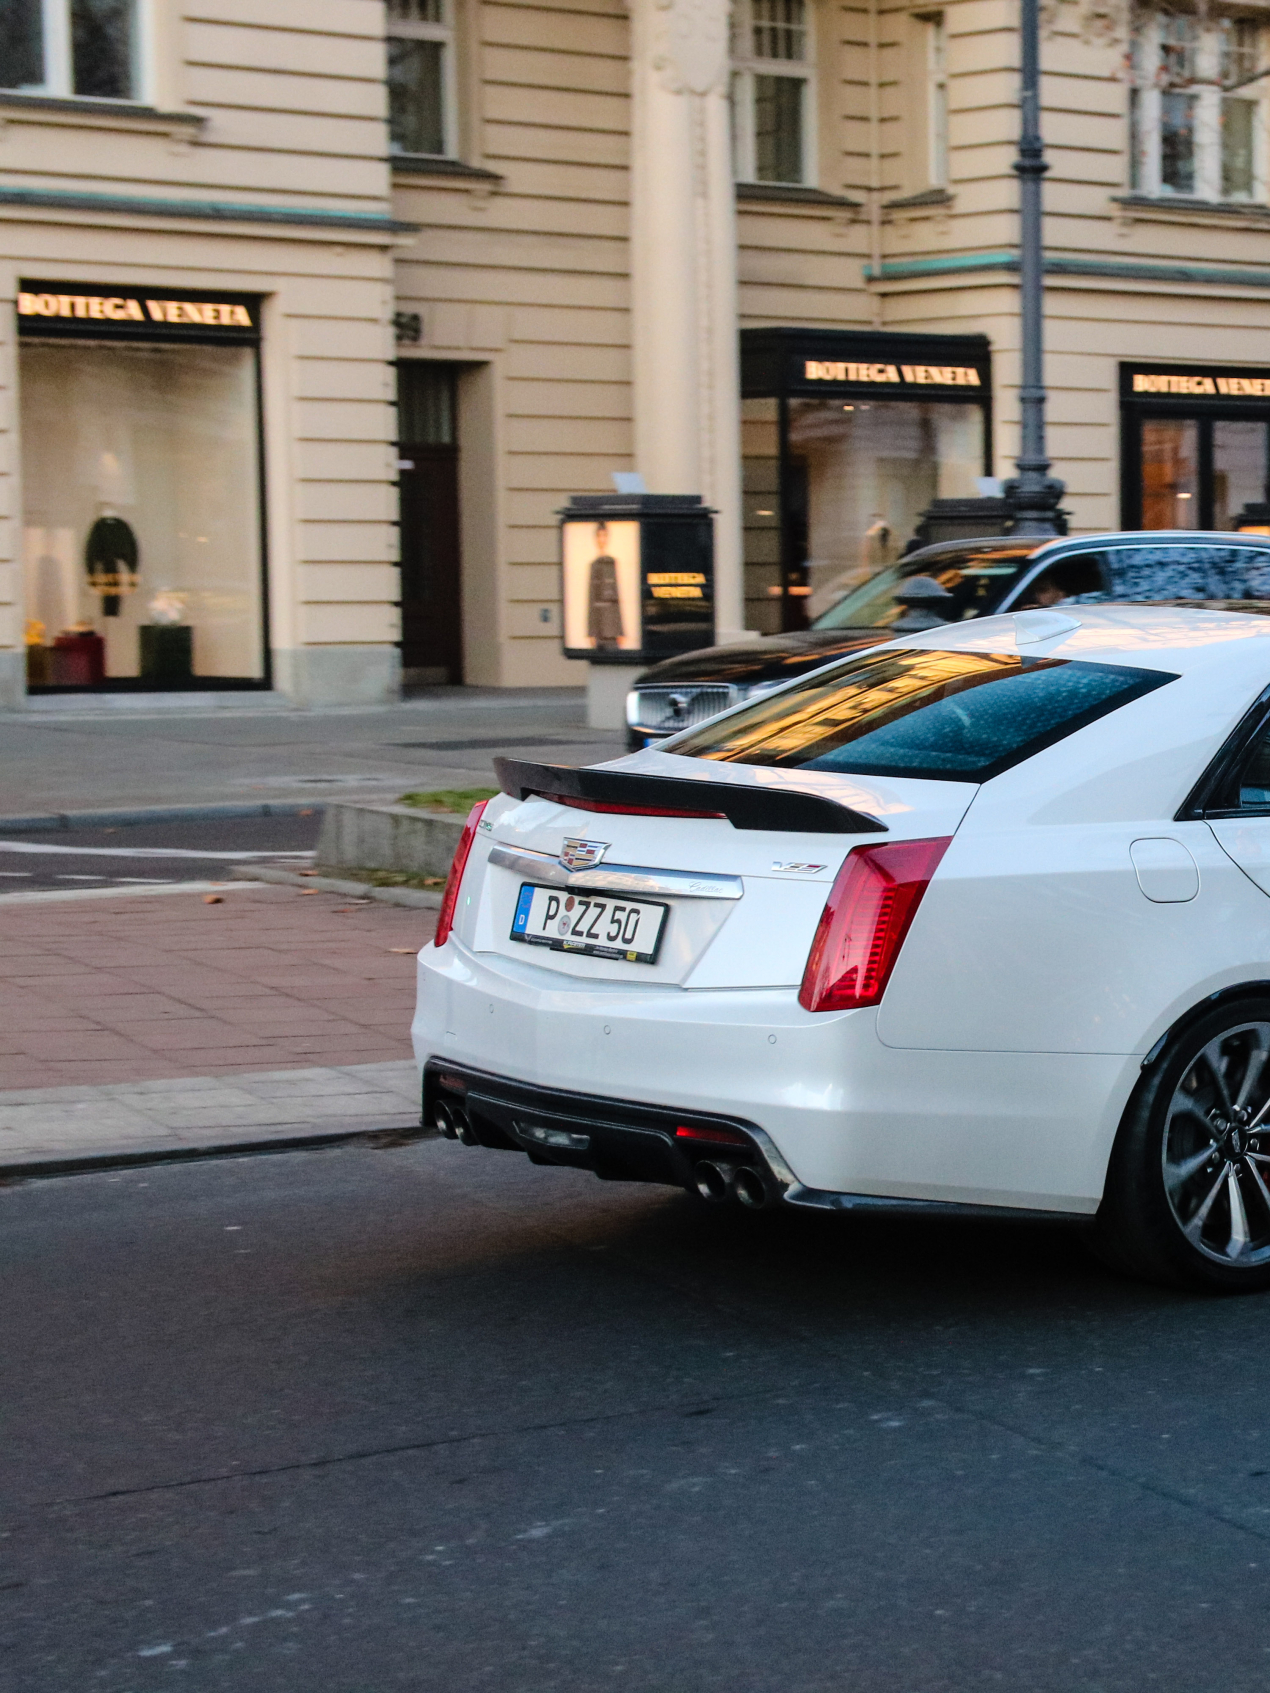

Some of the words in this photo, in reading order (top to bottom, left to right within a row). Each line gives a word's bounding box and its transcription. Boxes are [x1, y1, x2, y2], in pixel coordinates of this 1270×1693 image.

[18, 292, 145, 321] BOTTEGA
[146, 299, 253, 327] VENETA
[805, 360, 900, 383] BOTTEGA
[900, 364, 981, 387] VENETA
[1132, 374, 1217, 395] BOTTEGA
[518, 914, 526, 925] D
[542, 895, 561, 931] P
[571, 899, 607, 940] ZZ
[606, 905, 641, 945] 50
